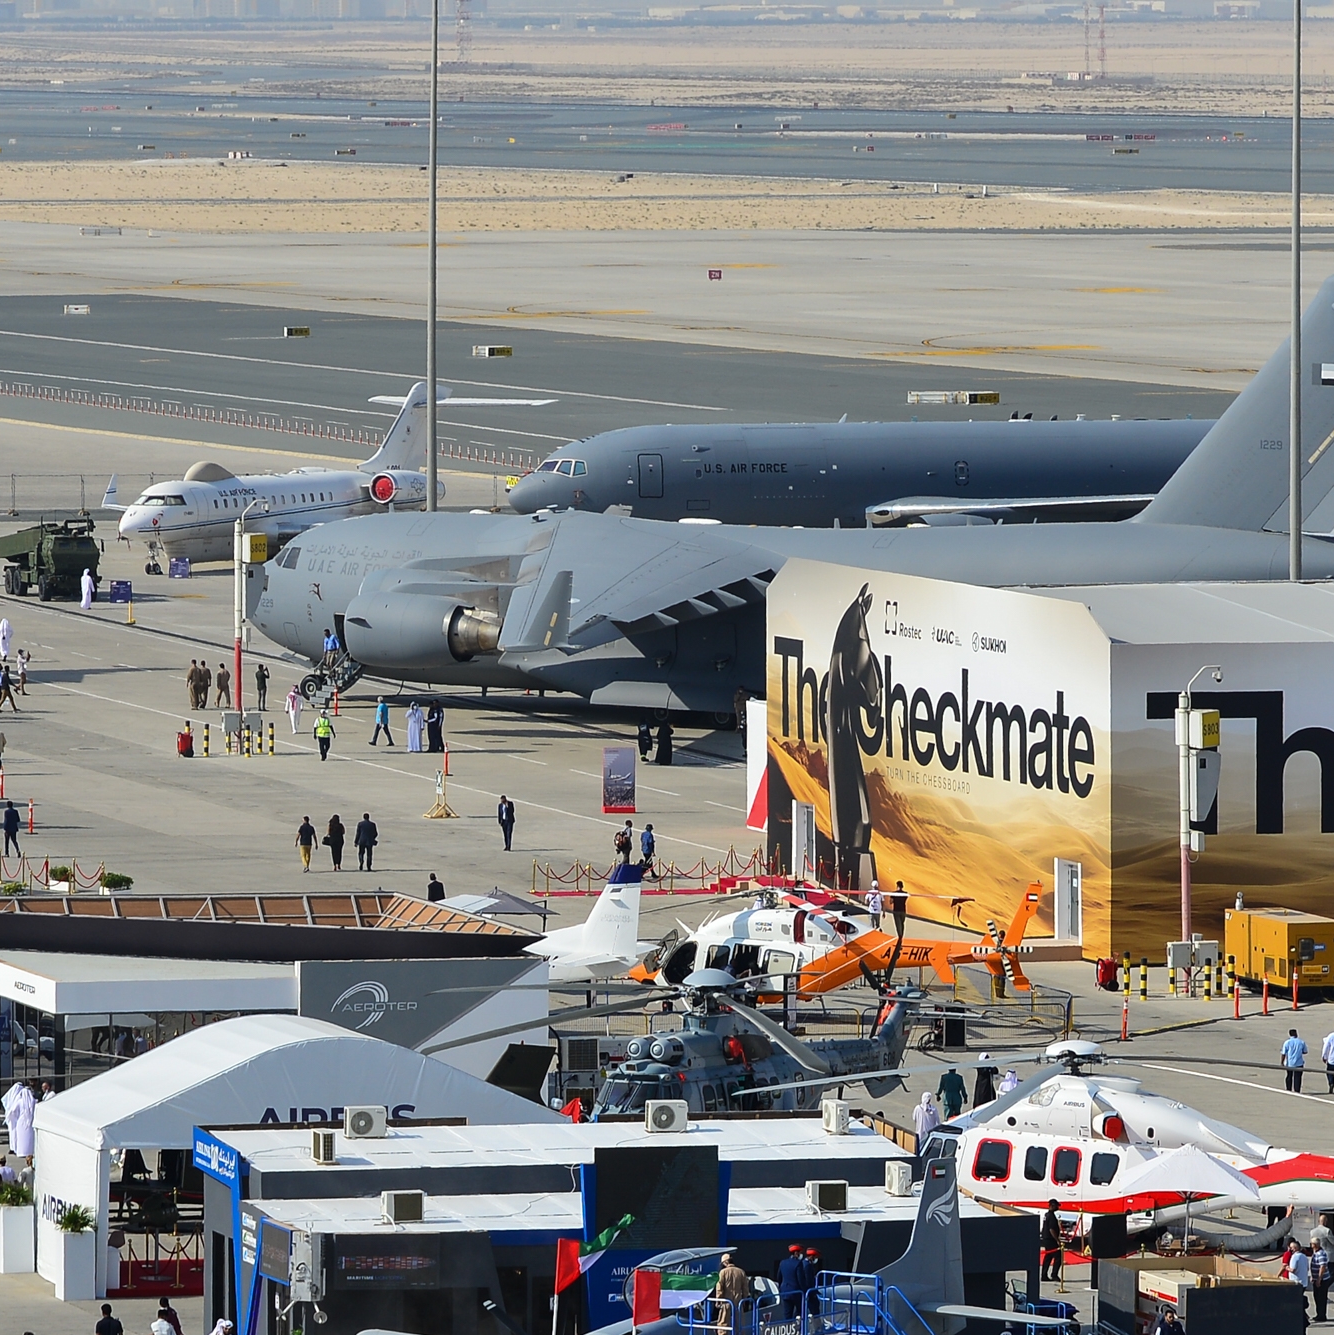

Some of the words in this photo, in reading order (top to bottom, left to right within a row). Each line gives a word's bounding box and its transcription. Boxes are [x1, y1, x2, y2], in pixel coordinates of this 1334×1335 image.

[1260, 440, 1283, 450] 1229
[704, 463, 726, 473] U.S.
[730, 463, 748, 473] AIR
[751, 463, 787, 473] FORCE
[307, 559, 336, 574] UAE
[340, 562, 360, 576] AIR
[899, 624, 922, 641] Rostec
[980, 636, 1007, 654] SUKHOI
[886, 765, 903, 782] TURN
[906, 770, 920, 785] THE
[922, 772, 971, 796] CHESSBOARD
[342, 1001, 418, 1013] AEROTER
[258, 1105, 417, 1124] AIRS
